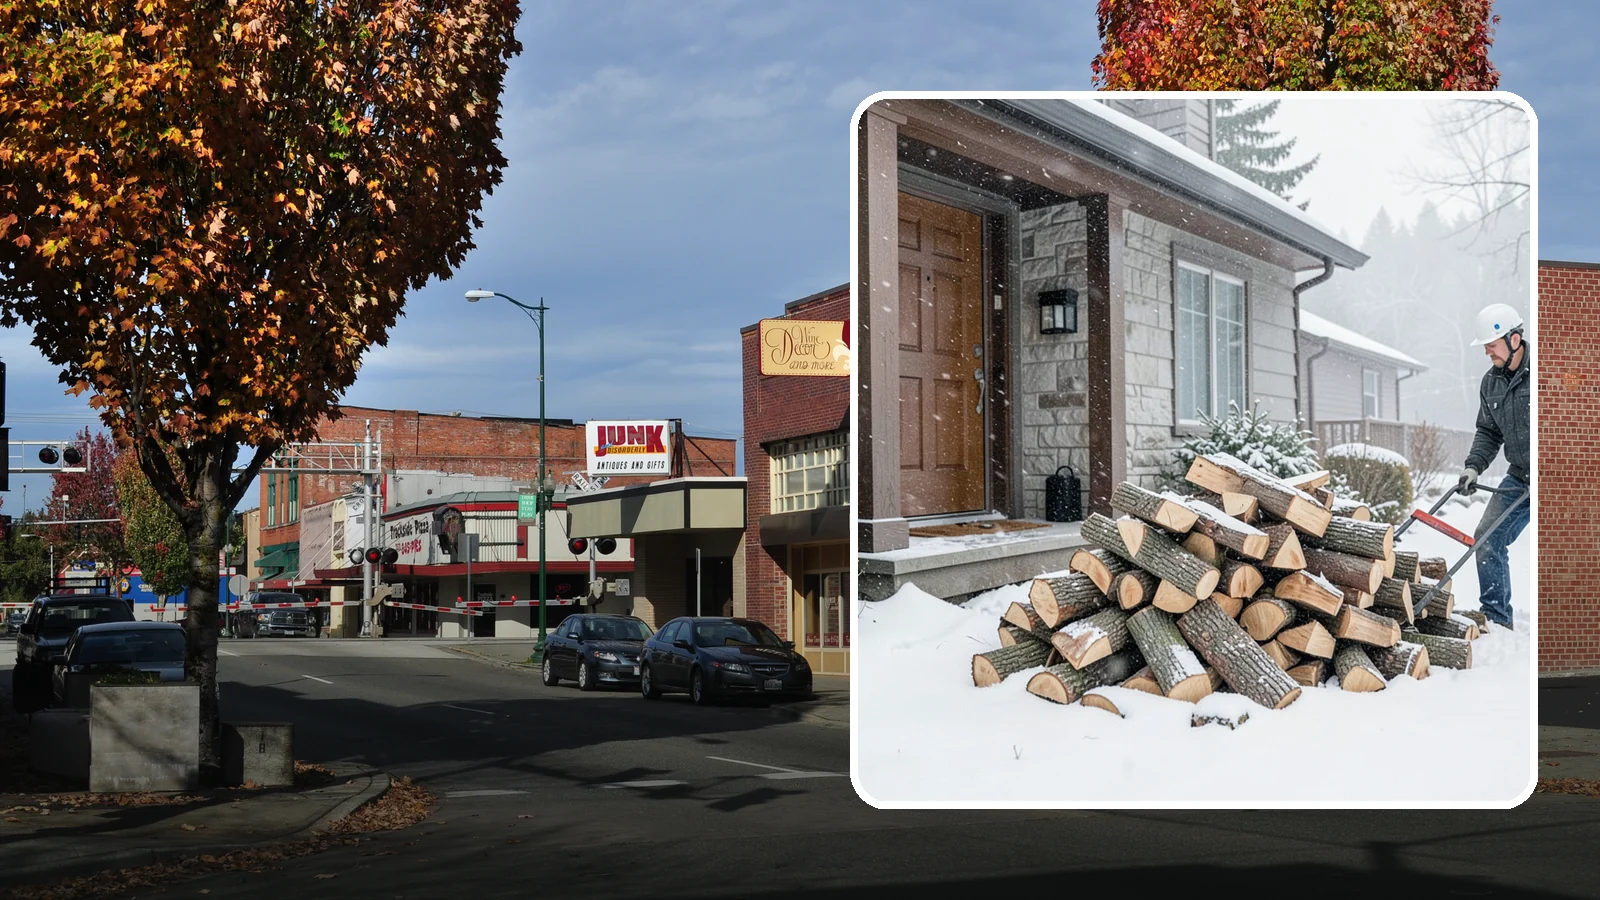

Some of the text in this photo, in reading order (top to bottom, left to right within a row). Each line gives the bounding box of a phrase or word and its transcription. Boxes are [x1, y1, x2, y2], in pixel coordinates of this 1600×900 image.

[765, 327, 831, 365] Decor
[595, 425, 665, 457] JUNK
[607, 446, 646, 454] DISORDERLY
[597, 460, 665, 470] ANTIQUES AND GIFTS
[415, 519, 429, 534] Pizza
